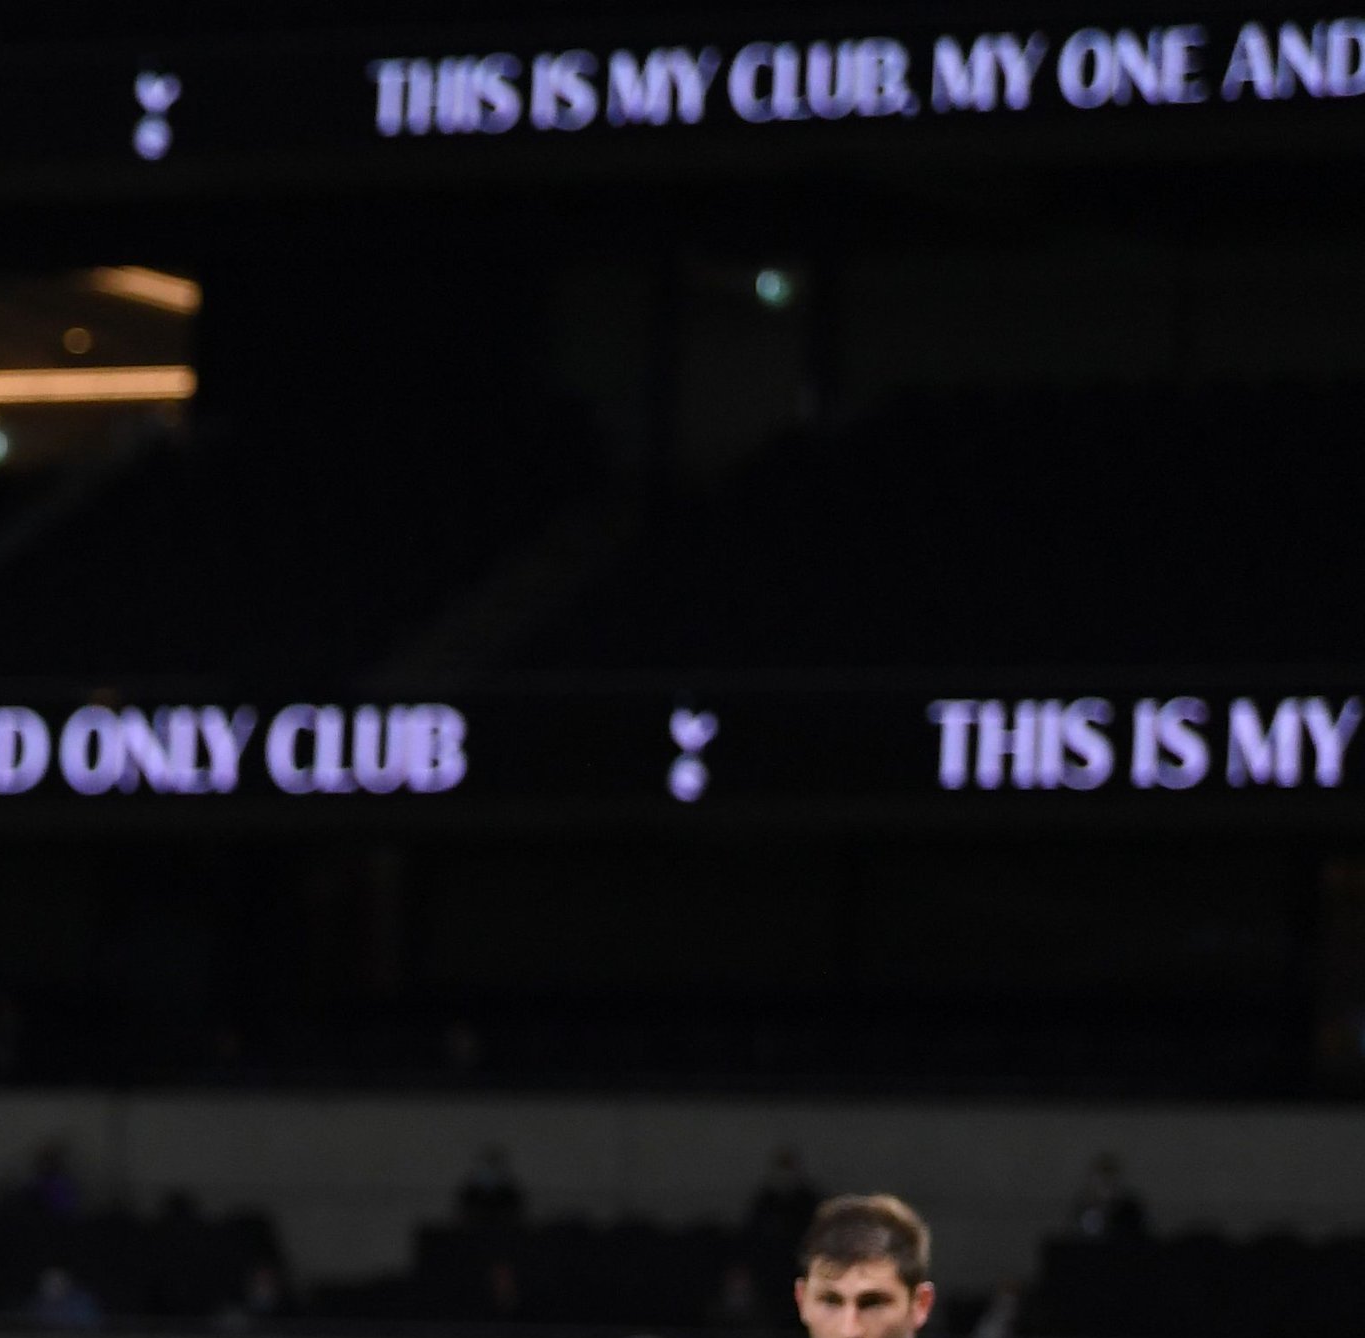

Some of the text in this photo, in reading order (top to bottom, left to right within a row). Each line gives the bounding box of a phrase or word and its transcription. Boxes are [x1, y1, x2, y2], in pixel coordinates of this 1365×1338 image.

[368, 52, 522, 137] THIS
[529, 48, 597, 131] IS
[606, 45, 723, 127] MY
[932, 30, 1049, 114] MY
[1057, 24, 1208, 109] ONE
[1221, 17, 1365, 100] AND
[59, 704, 257, 794] ONLY
[266, 703, 467, 794] CLUB
[927, 695, 1364, 790] THIS IS MY
